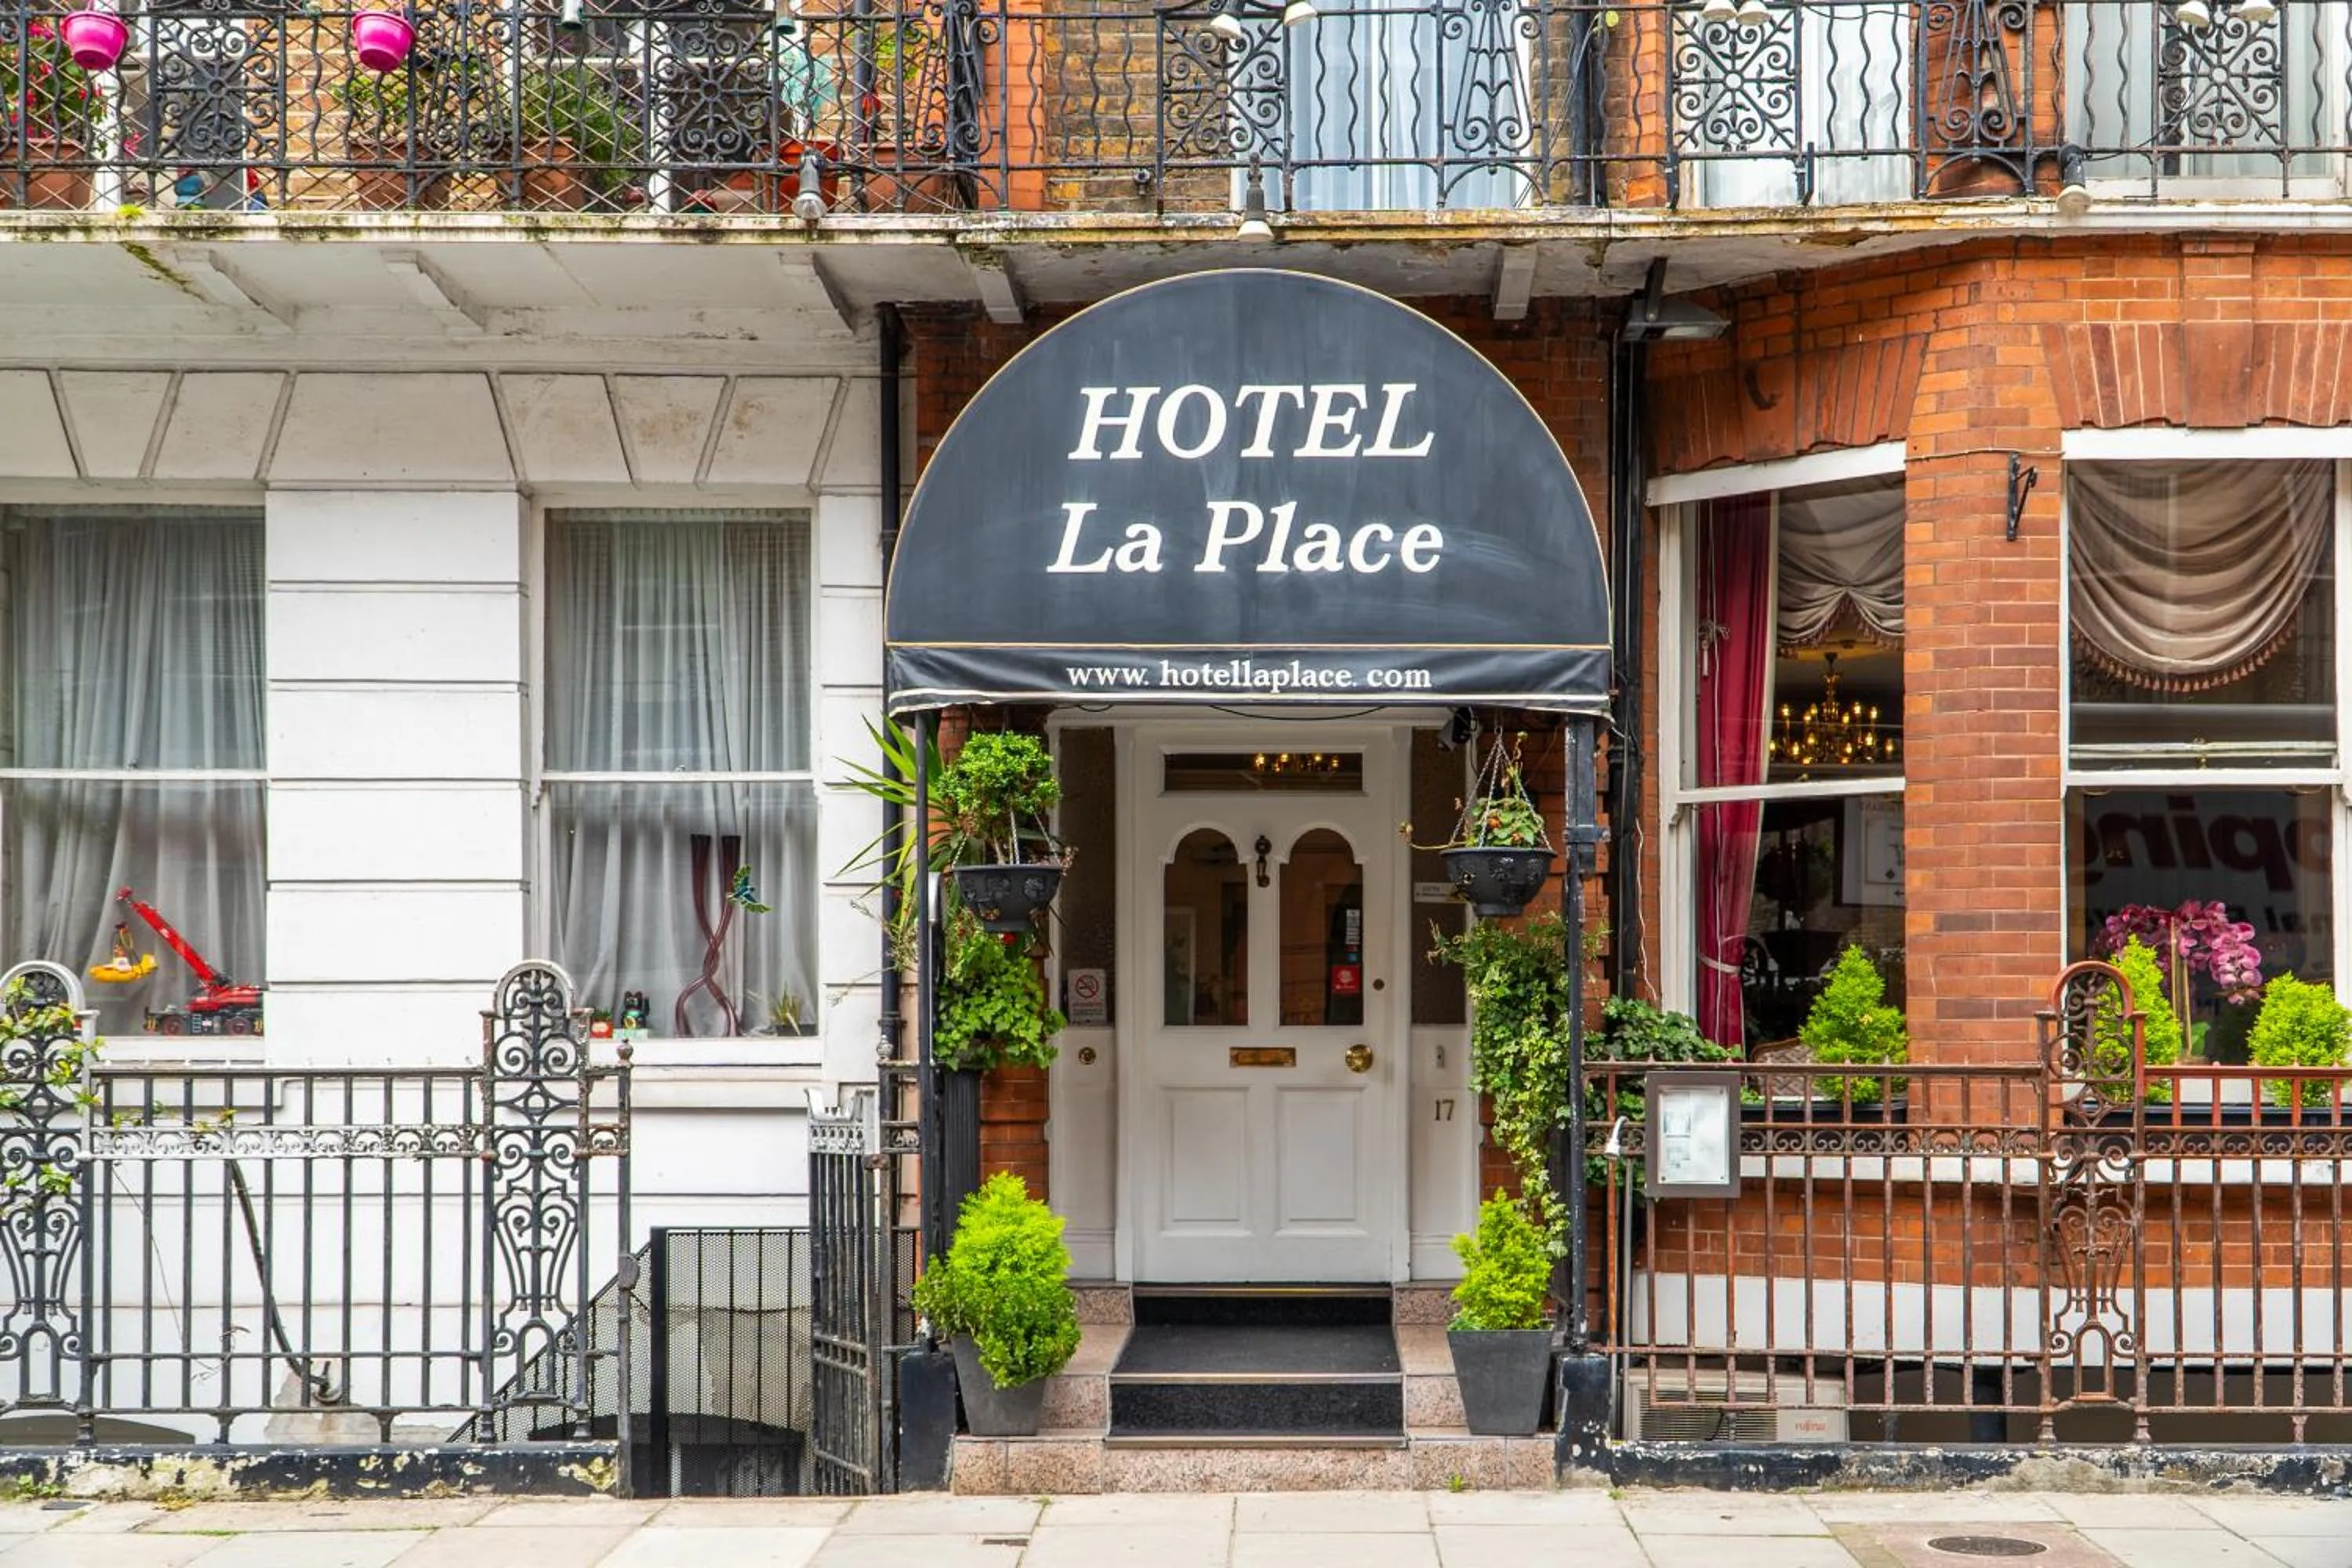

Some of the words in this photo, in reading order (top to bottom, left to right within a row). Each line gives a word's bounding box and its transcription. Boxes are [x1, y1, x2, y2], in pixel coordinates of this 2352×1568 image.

[1068, 383, 1435, 459] HOTEL
[1047, 503, 1163, 573] La
[1194, 501, 1443, 573] Place
[1067, 666, 1149, 688] www.
[1160, 659, 1357, 694] hotellaplace.
[1367, 668, 1432, 688] com
[1436, 1099, 1455, 1121] 17
